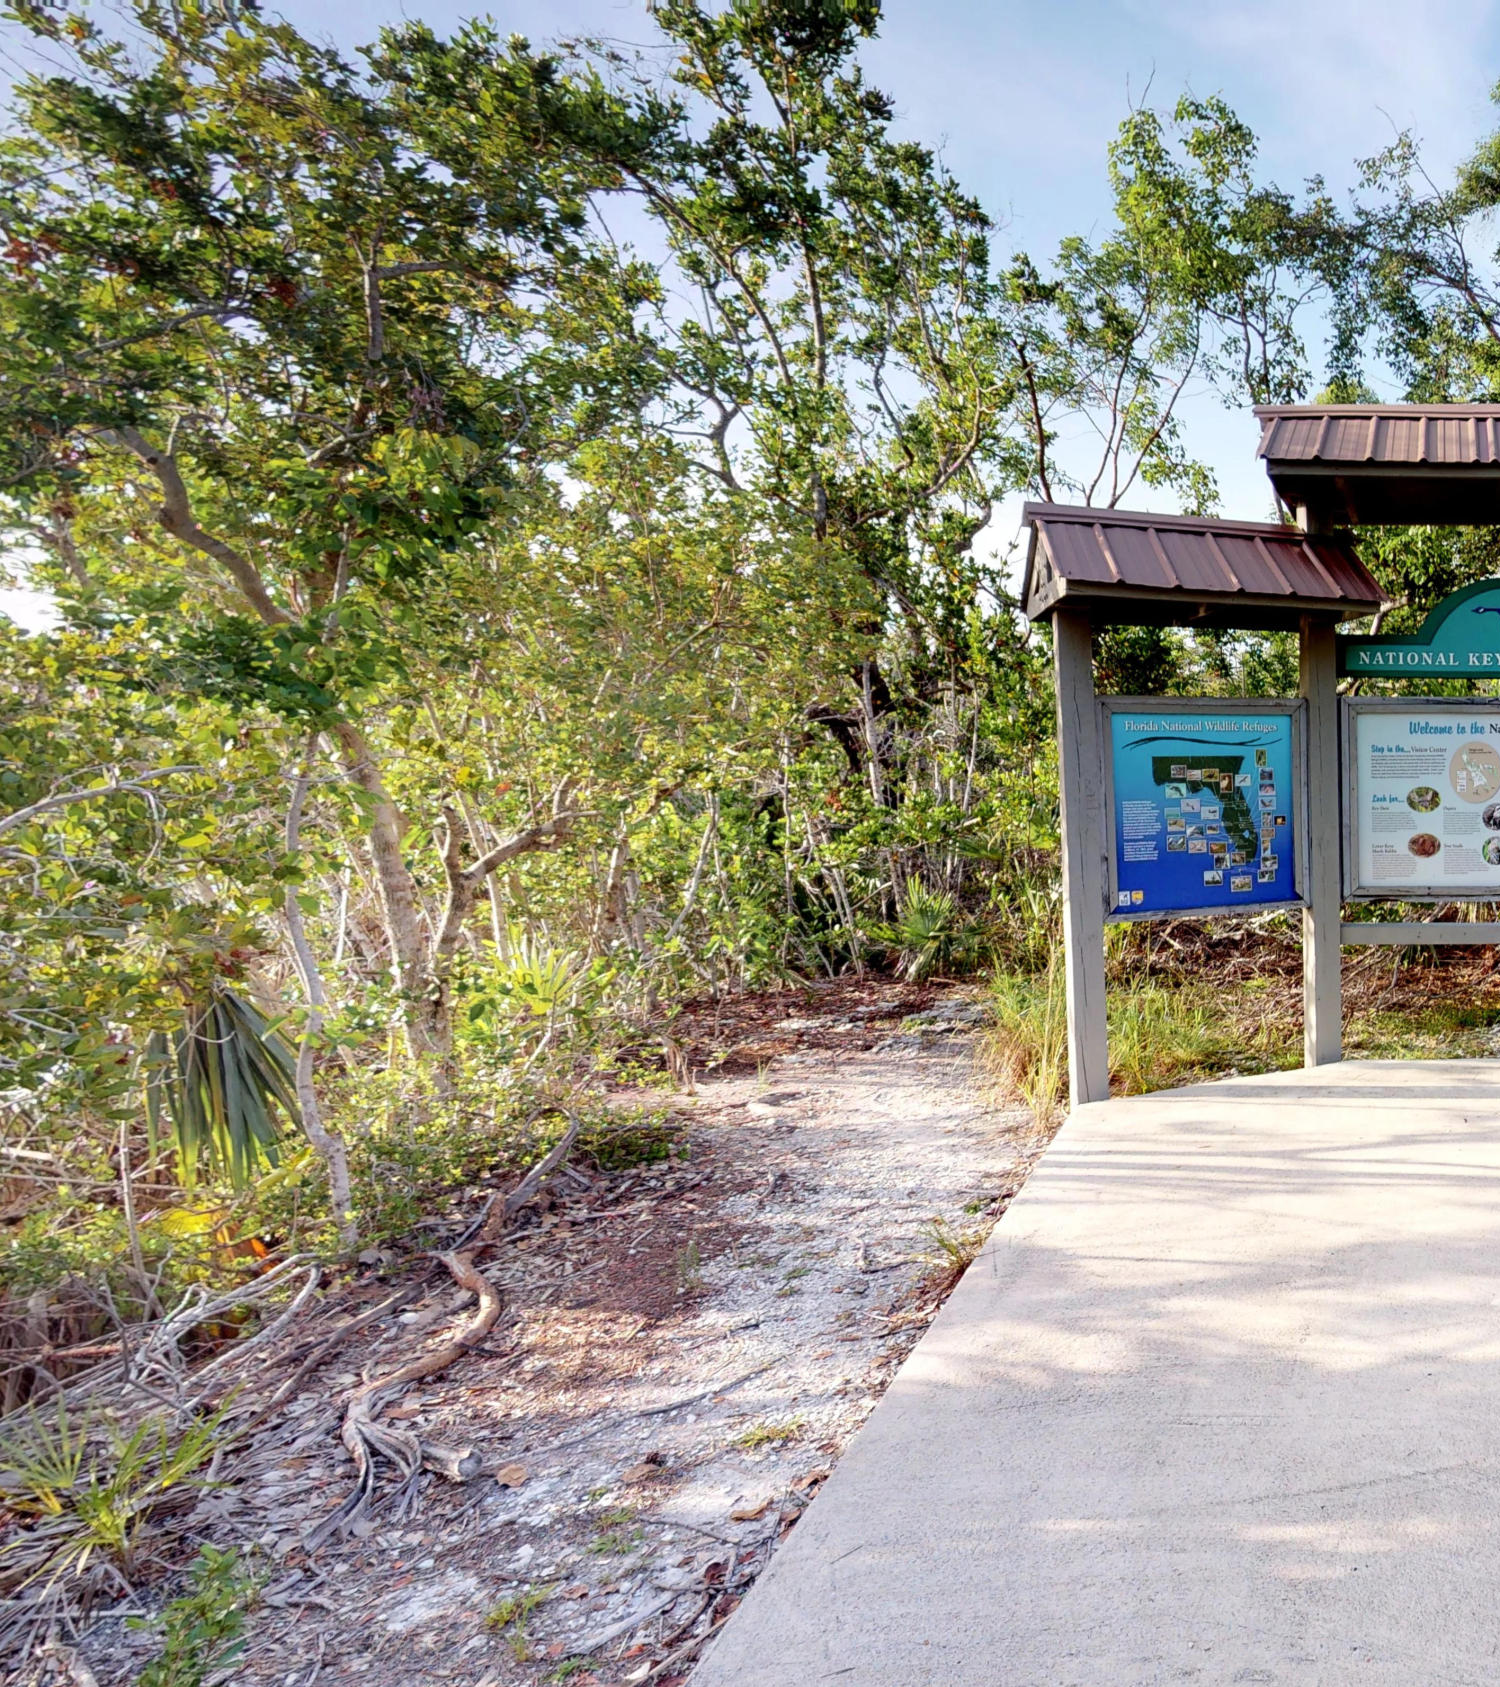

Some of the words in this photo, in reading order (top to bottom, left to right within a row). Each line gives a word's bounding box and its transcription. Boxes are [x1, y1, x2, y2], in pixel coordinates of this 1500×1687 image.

[1359, 652, 1459, 667] NATIONAL
[1124, 720, 1159, 732] Florida
[1161, 720, 1202, 732] National
[1205, 720, 1240, 732] Wildlife
[1242, 721, 1278, 734] Refuges
[1408, 721, 1453, 735] Welcome
[1456, 722, 1466, 735] to
[1470, 721, 1485, 735] the
